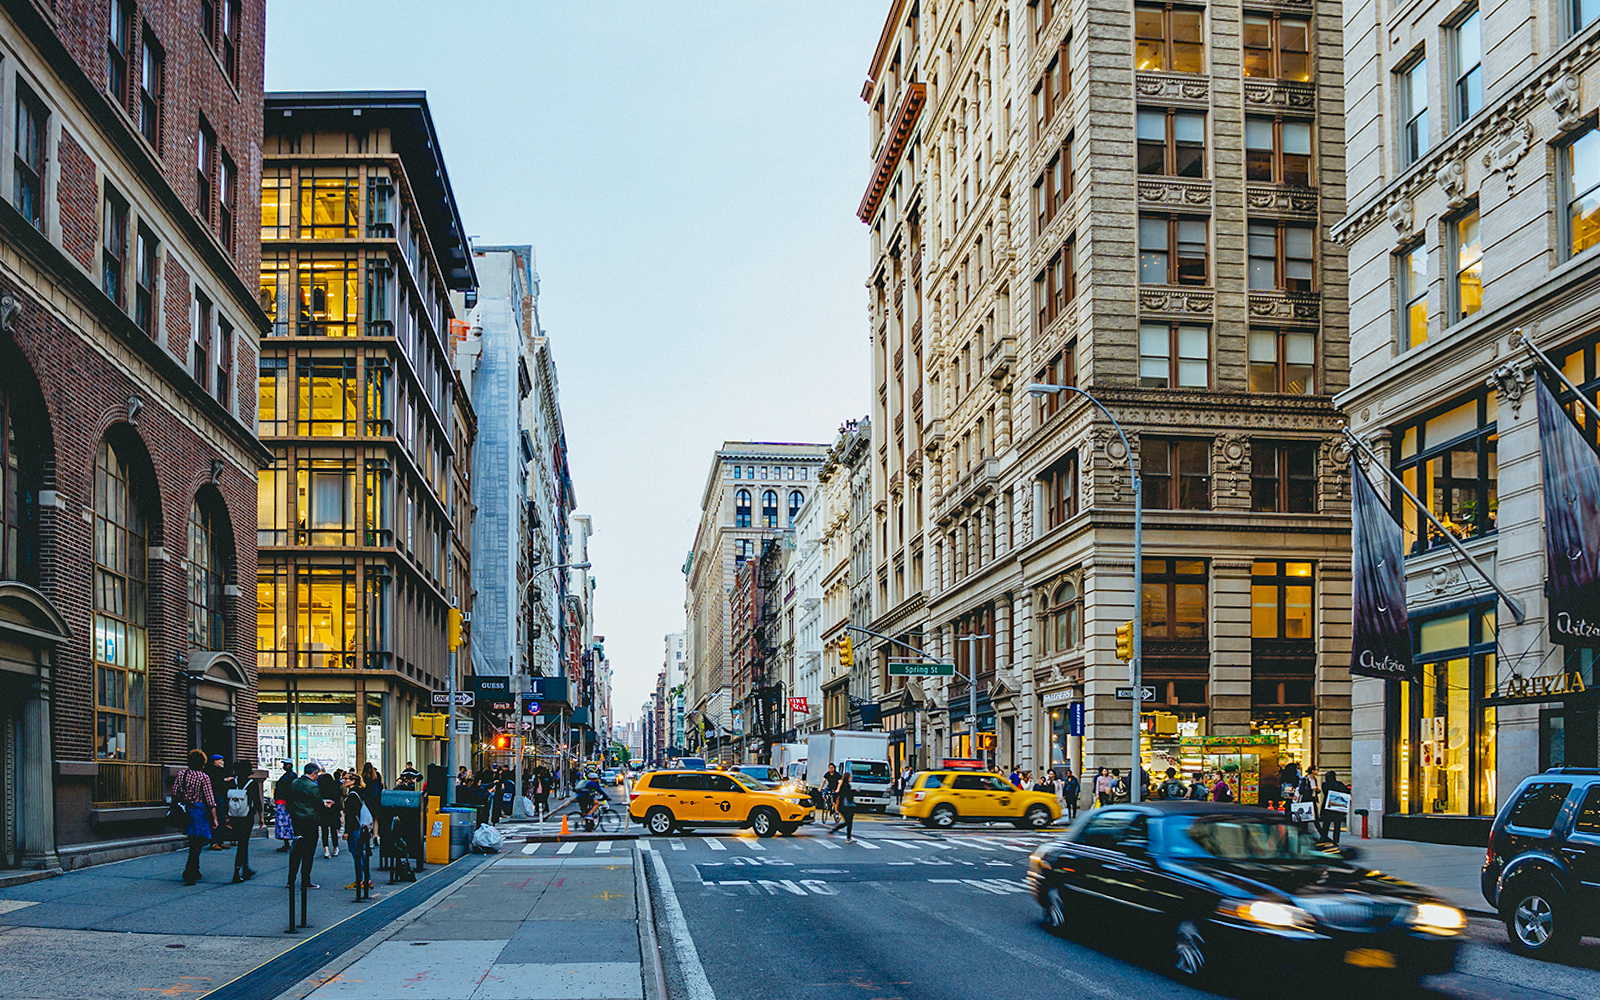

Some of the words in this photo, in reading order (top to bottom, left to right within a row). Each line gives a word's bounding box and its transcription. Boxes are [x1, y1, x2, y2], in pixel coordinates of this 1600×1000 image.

[905, 666, 928, 675] Spring
[1359, 650, 1406, 672] Aritzia
[1506, 671, 1586, 699] ARITZIA
